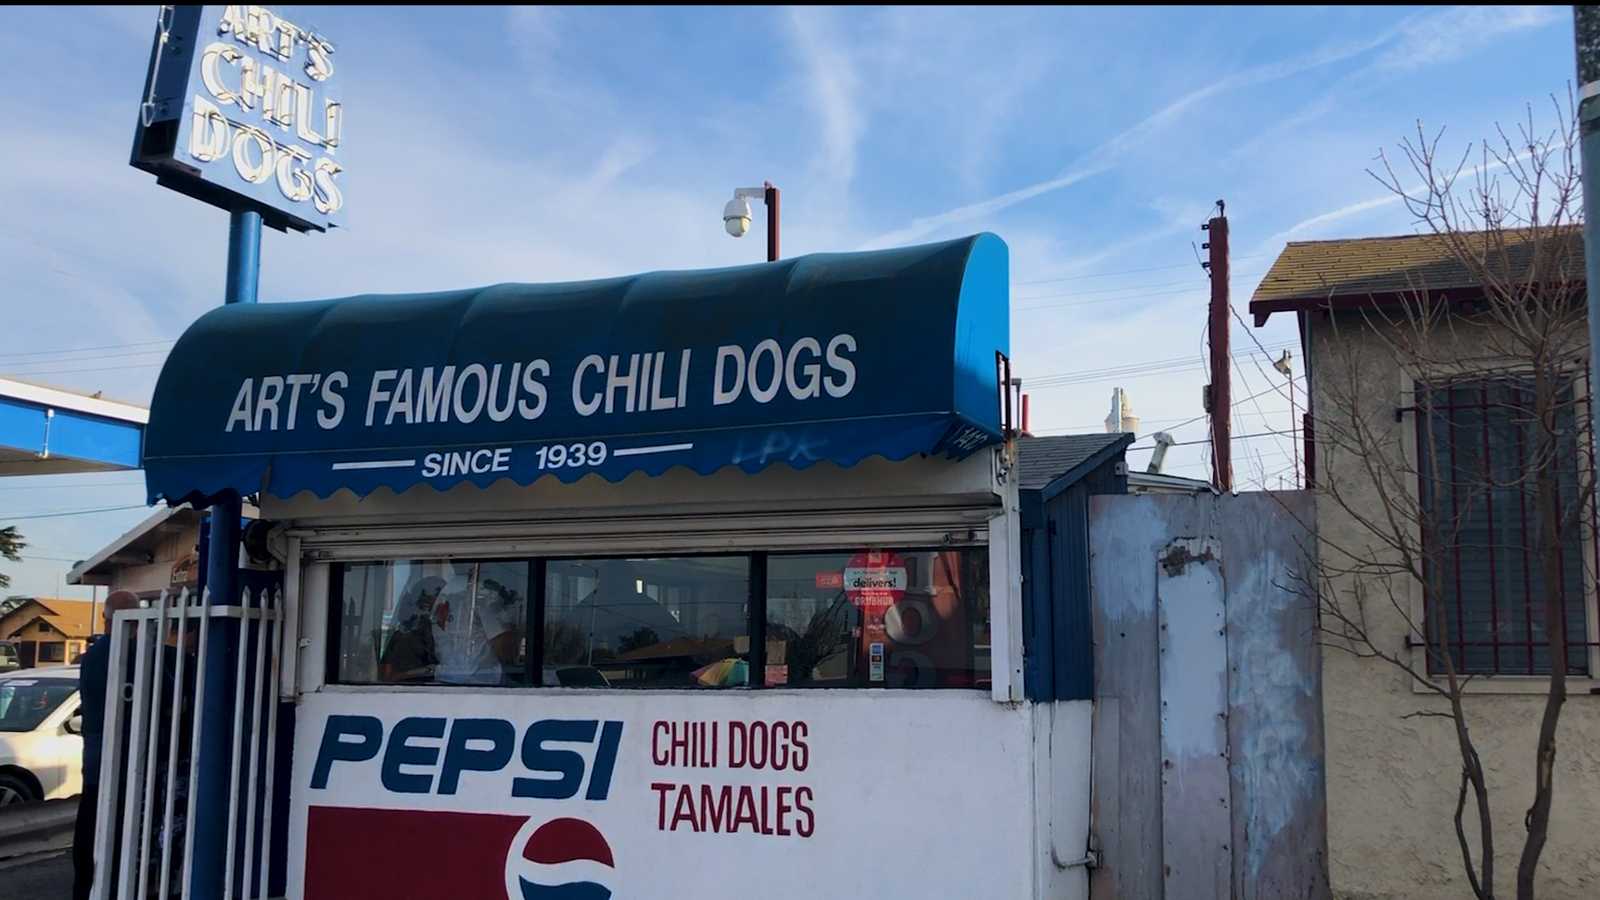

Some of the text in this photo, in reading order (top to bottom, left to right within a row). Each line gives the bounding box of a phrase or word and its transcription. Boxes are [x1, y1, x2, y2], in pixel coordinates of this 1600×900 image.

[217, 5, 335, 81] ART'S
[201, 42, 342, 155] CHILI
[189, 95, 343, 214] DOGS
[225, 333, 857, 432] ART'S FAMOUS CHILI DOGS
[421, 441, 607, 478] SINCE 1939
[853, 577, 897, 588] delivers!
[310, 714, 624, 800] PEPSI
[652, 720, 809, 771] CHILI DOGS
[651, 783, 814, 837] TAMALES
